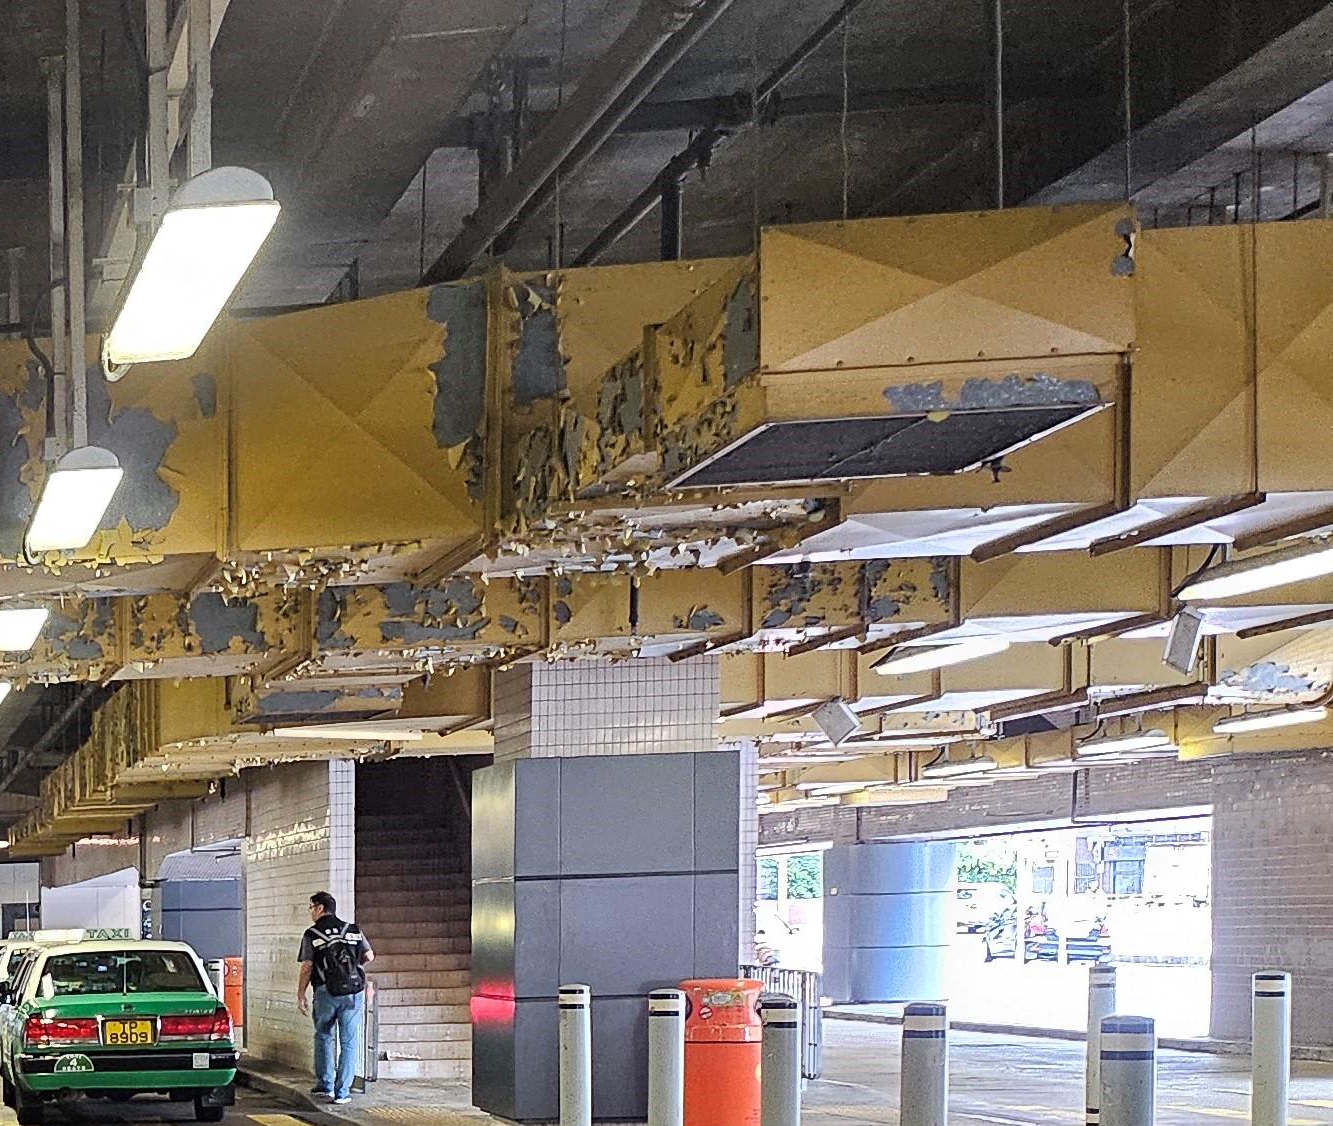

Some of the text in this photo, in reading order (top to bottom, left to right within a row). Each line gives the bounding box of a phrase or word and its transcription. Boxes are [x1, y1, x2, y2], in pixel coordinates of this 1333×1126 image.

[86, 928, 130, 939] TAXI
[119, 1021, 139, 1034] TP
[109, 1032, 149, 1044] 8909
[69, 1058, 78, 1067] 4
